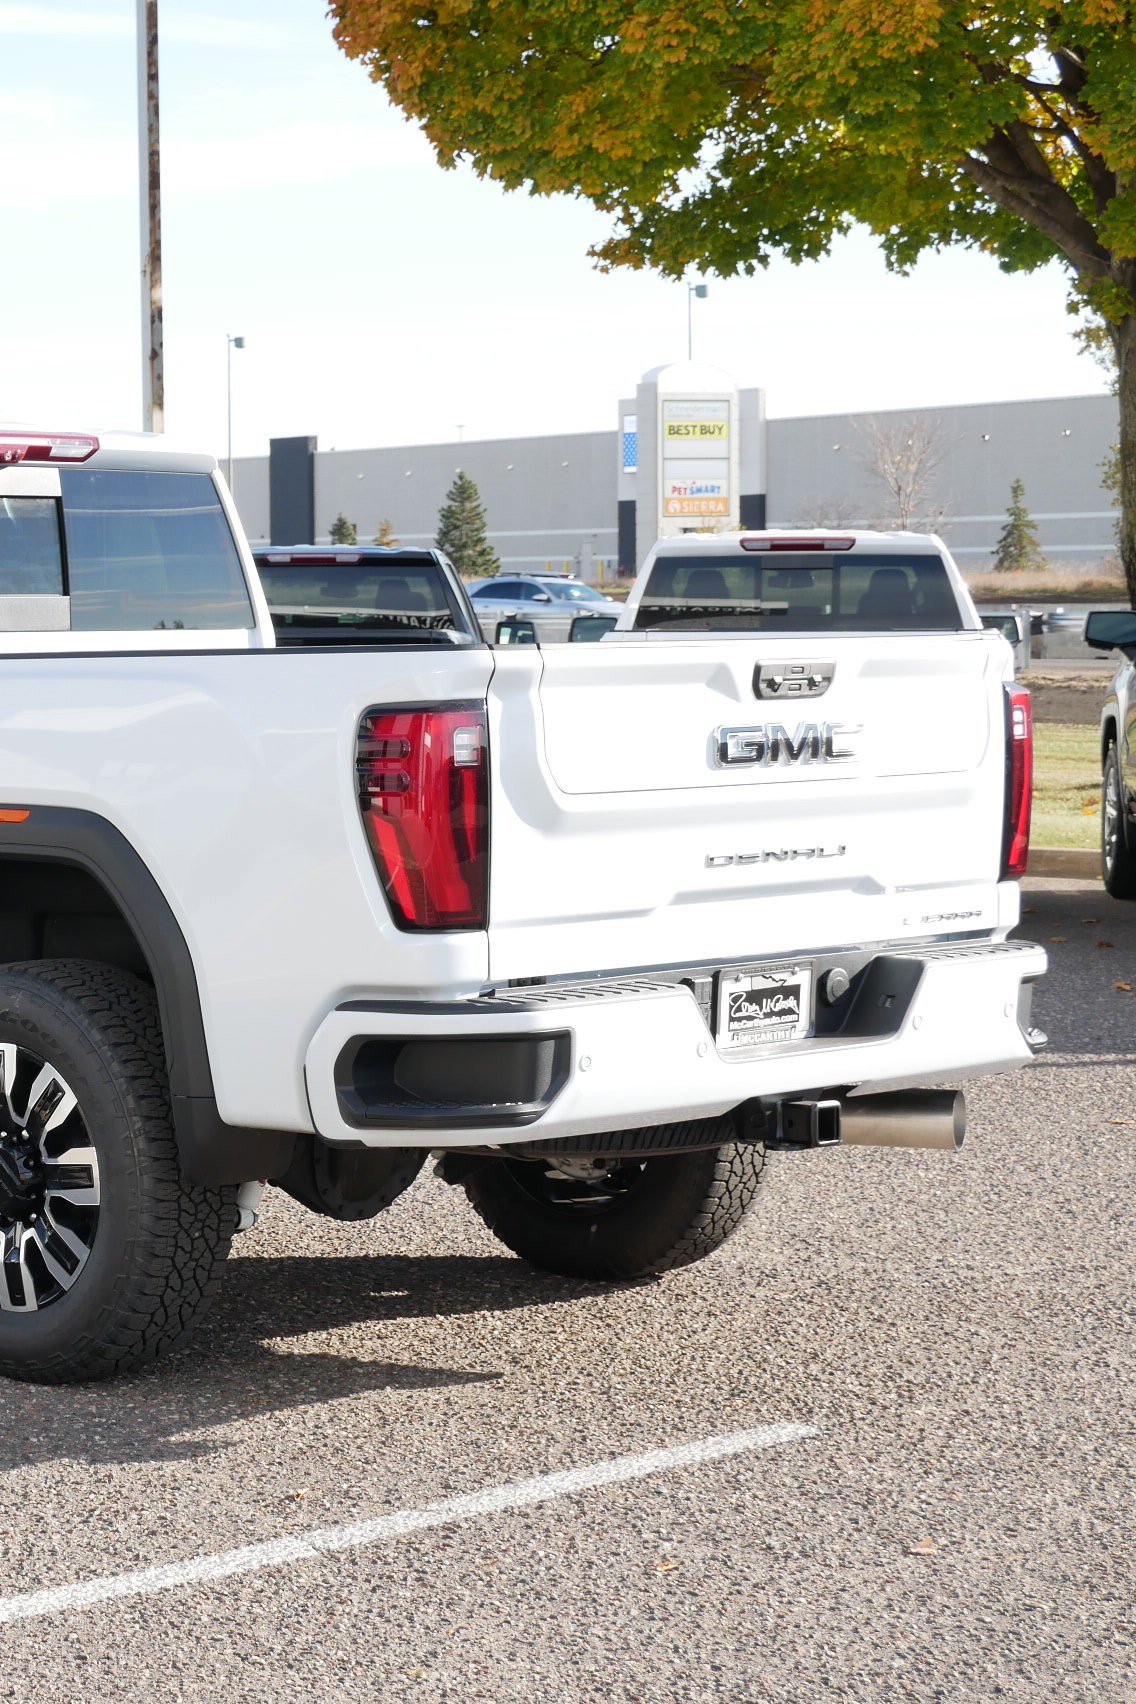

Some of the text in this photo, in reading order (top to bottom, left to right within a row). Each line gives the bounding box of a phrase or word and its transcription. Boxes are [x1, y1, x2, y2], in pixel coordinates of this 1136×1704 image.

[668, 424, 724, 435] BEST BUY
[682, 501, 725, 513] SIERRA
[708, 721, 863, 770] GMC
[704, 845, 846, 869] DENALI
